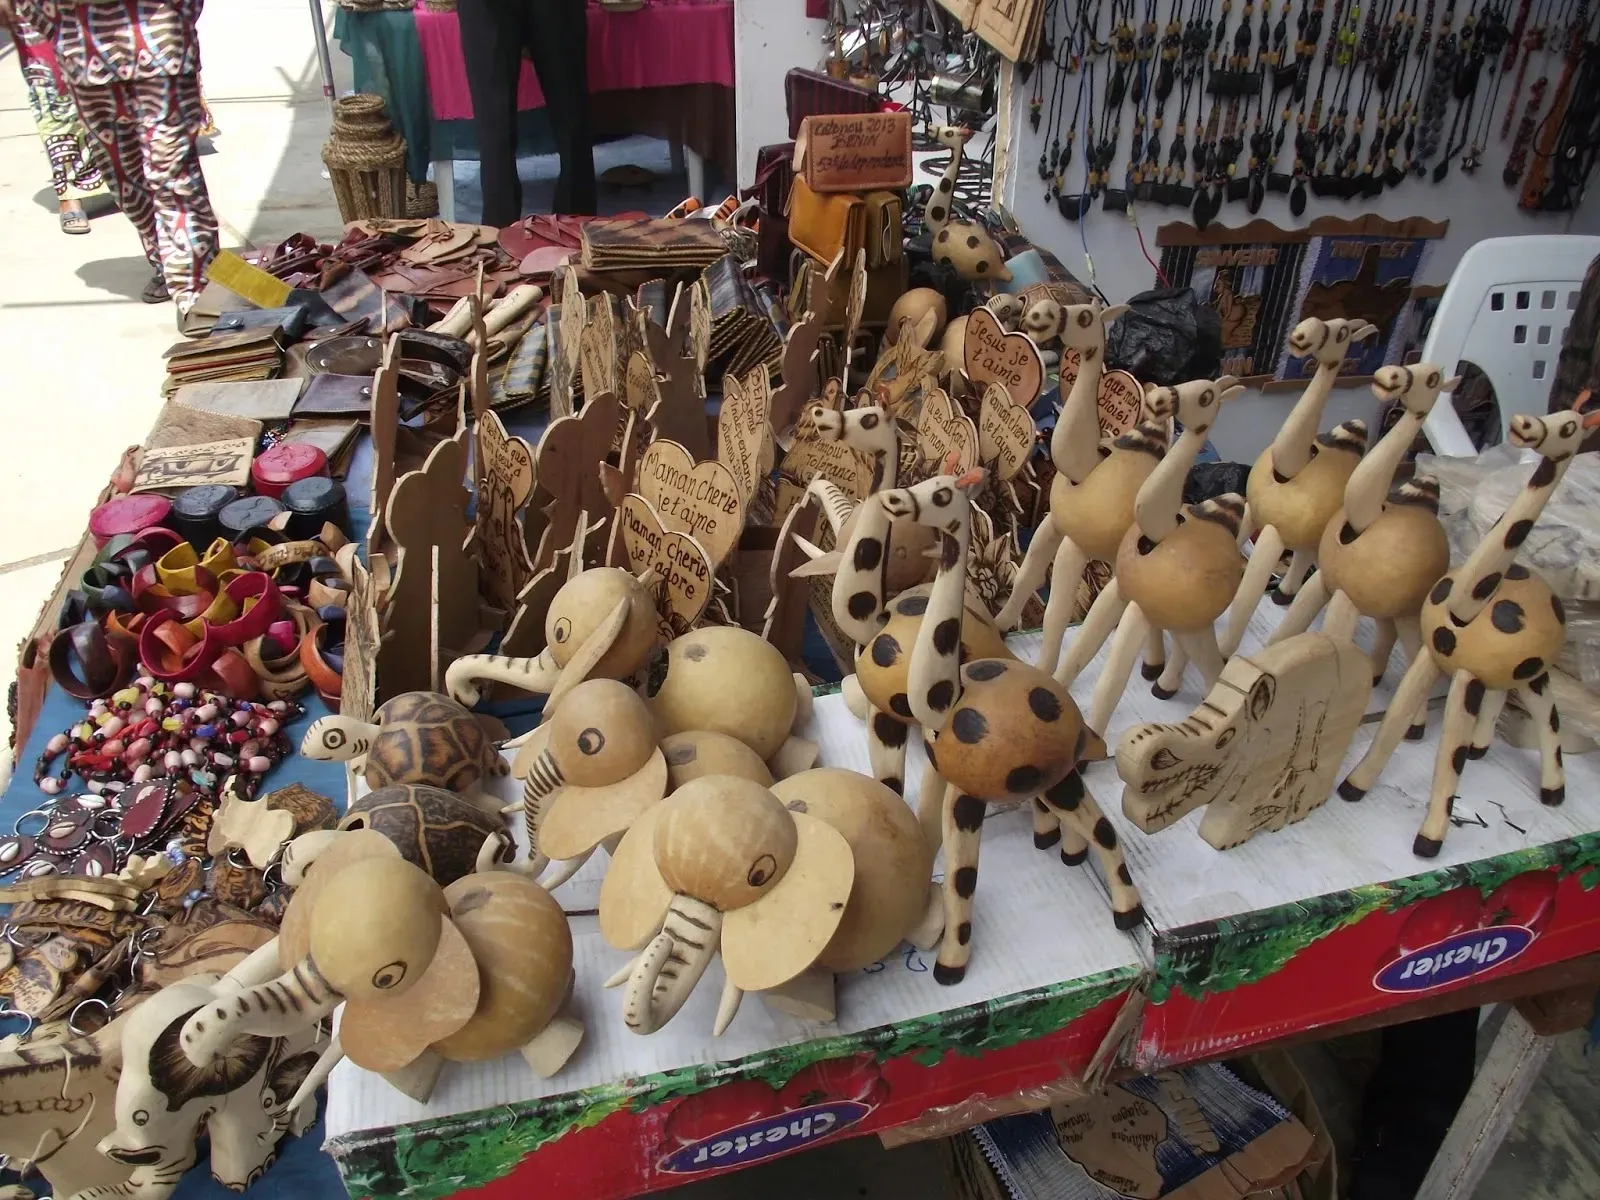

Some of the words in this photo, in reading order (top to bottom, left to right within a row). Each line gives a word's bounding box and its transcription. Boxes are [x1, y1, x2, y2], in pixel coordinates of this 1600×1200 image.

[969, 319, 1008, 352] Jesus
[1008, 345, 1030, 367] je
[644, 452, 697, 499] Maman
[623, 506, 662, 551] Maman
[1399, 935, 1510, 981] Chester
[693, 1111, 837, 1164] Chester
